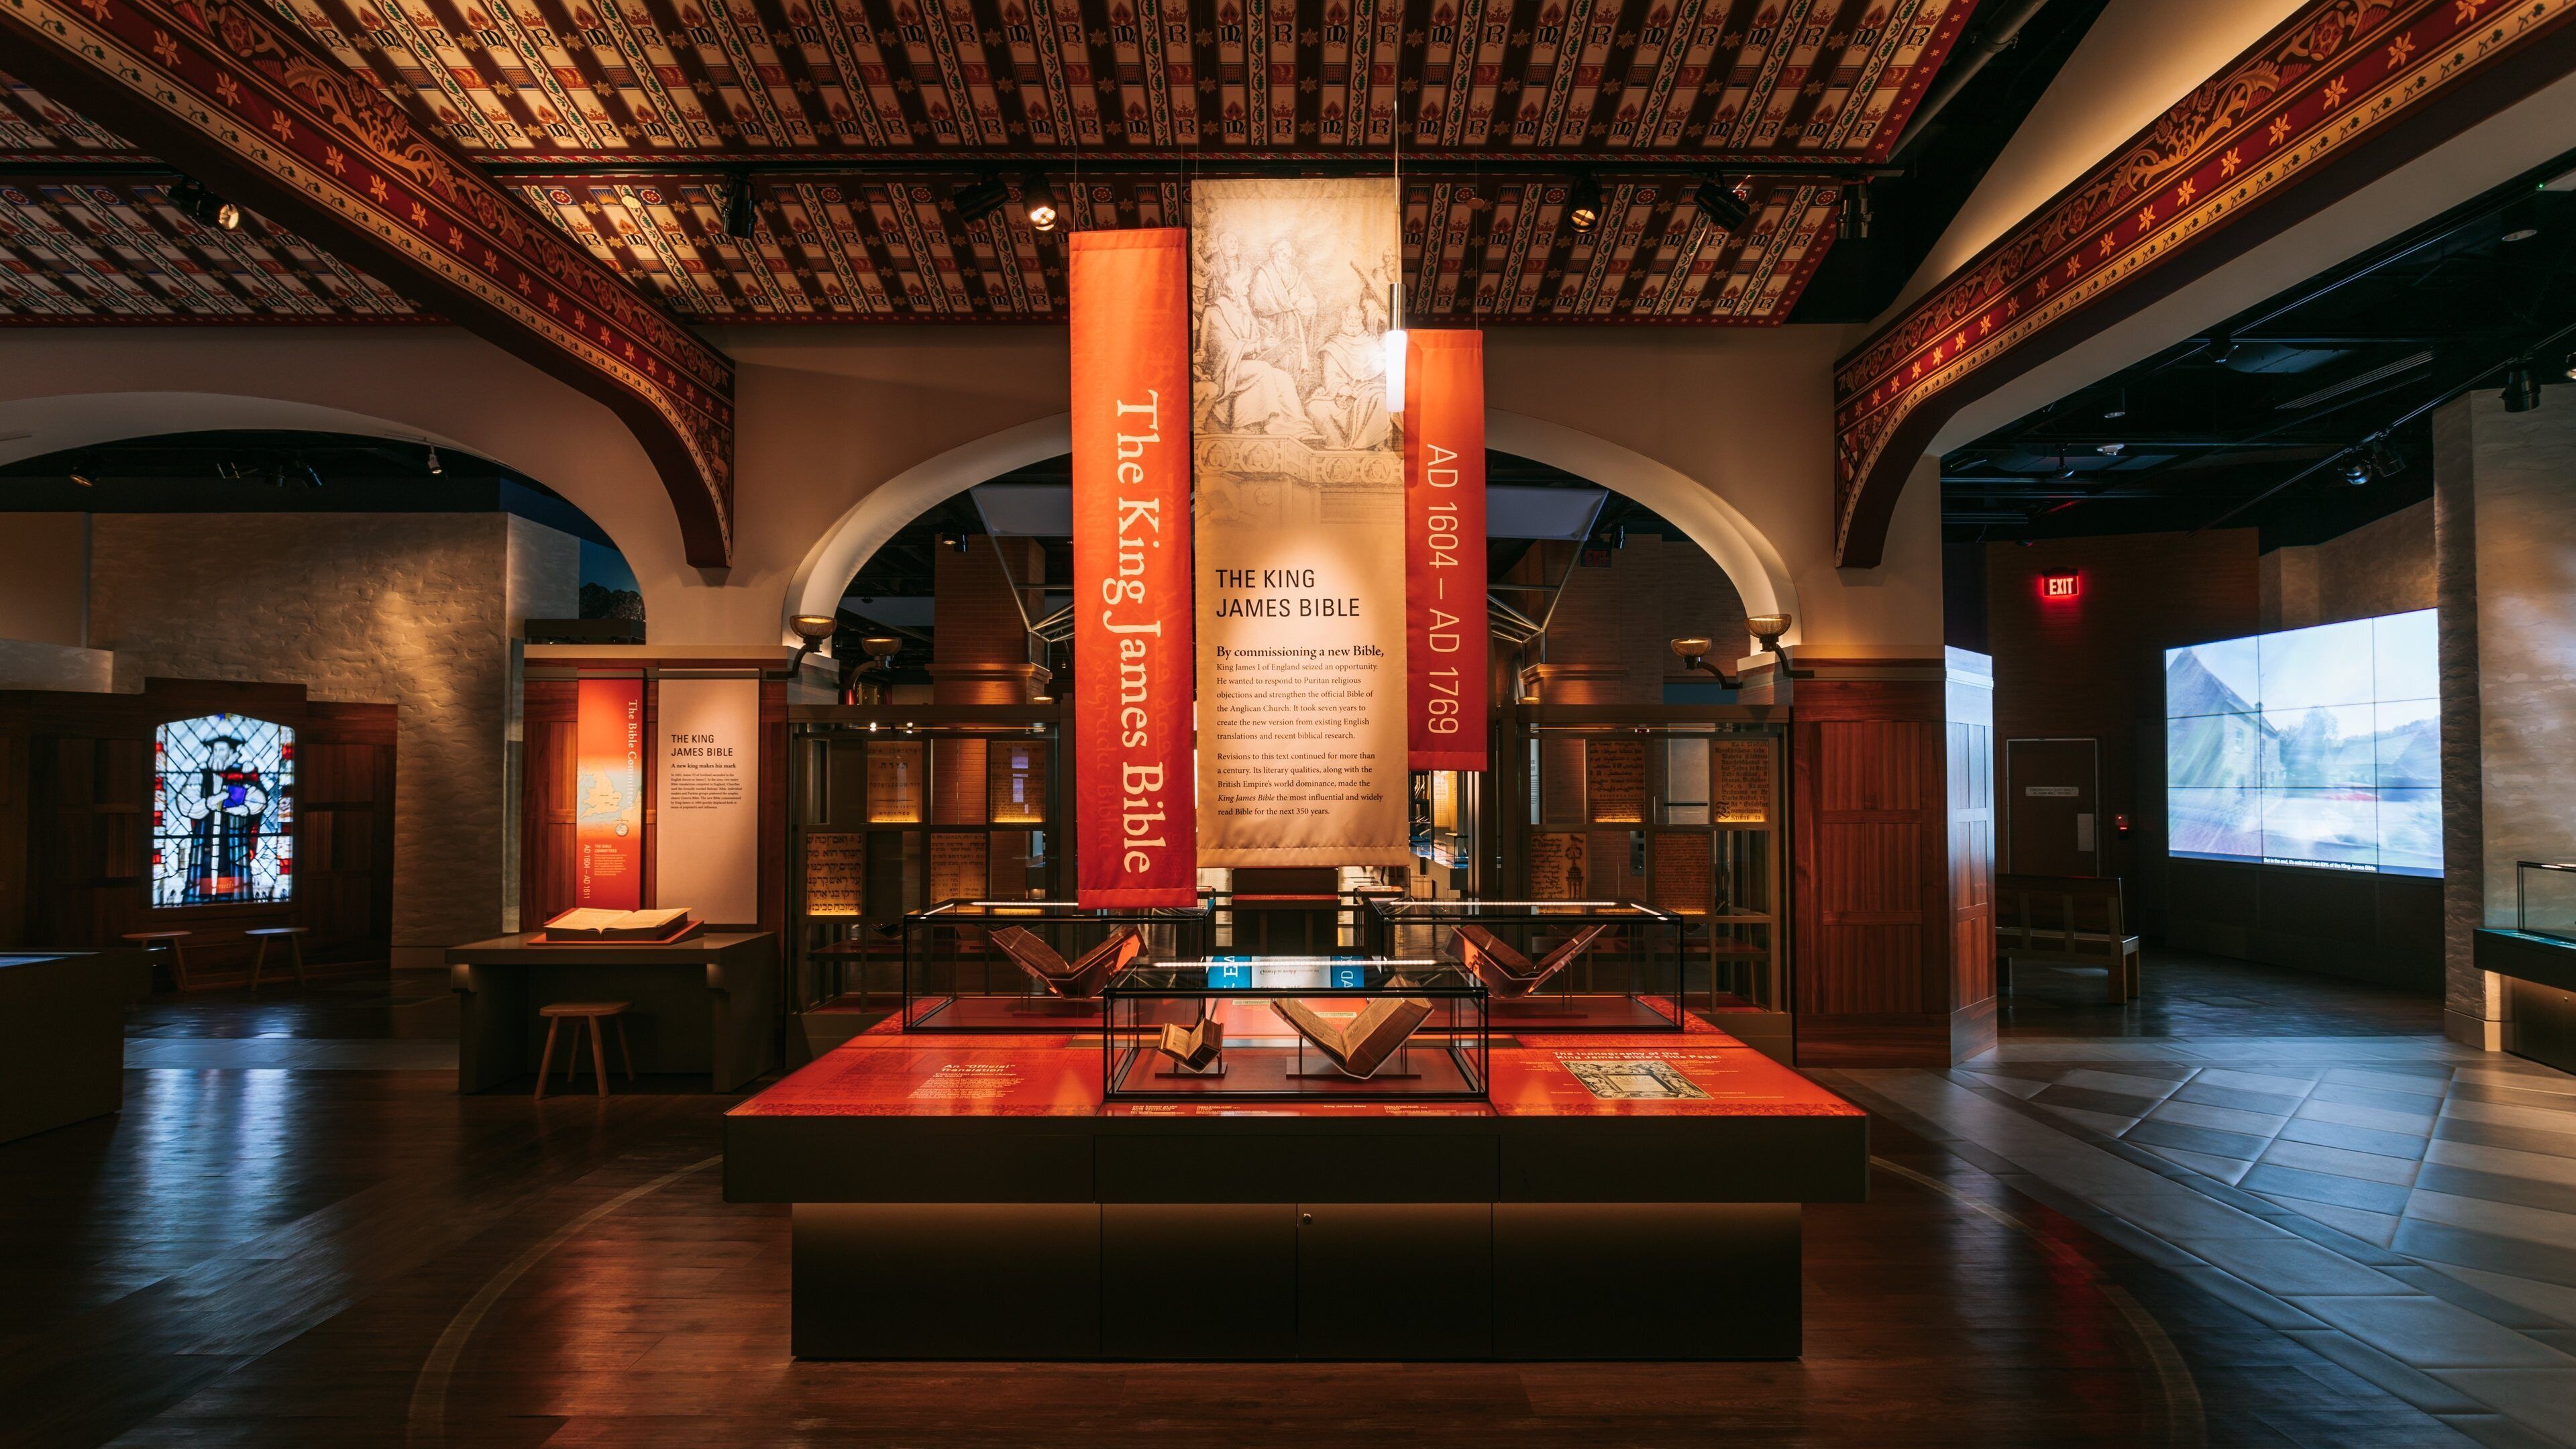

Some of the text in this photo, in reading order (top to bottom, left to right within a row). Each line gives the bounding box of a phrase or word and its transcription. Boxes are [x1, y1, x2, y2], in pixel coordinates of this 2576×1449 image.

[1428, 443, 1458, 487] AD
[1428, 502, 1458, 568] 1604
[1216, 570, 1314, 588] THE KING
[2049, 578, 2074, 594] EXIT
[1216, 598, 1359, 617] JAMES BIBLE
[1103, 390, 1166, 873] The King James Bible
[1430, 608, 1459, 652] AD
[1217, 646, 1231, 660] By
[1234, 647, 1317, 660] commissioning
[1354, 645, 1384, 657] Bible,
[1217, 664, 1234, 672] King
[1272, 663, 1299, 672] England
[1336, 663, 1378, 672] opportunity.
[1265, 677, 1293, 686] respond
[1332, 677, 1361, 686] religious
[1217, 691, 1252, 700] objections
[1269, 691, 1305, 700] strengthen
[1428, 667, 1458, 733] 1769
[1230, 705, 1260, 714] Anglican
[1315, 718, 1342, 727] existing
[1344, 718, 1369, 727] English
[672, 735, 714, 743] THE KING
[628, 700, 638, 810] The Bible Committees
[672, 748, 733, 756] JAMES BIBLE
[1263, 767, 1288, 775] literary
[1291, 766, 1321, 775] qualities,
[1323, 766, 1342, 775] along
[1243, 780, 1272, 789] Empire's
[1218, 795, 1234, 803] King
[1360, 794, 1383, 802] widely
[584, 845, 591, 853] AD
[584, 875, 590, 884] AD
